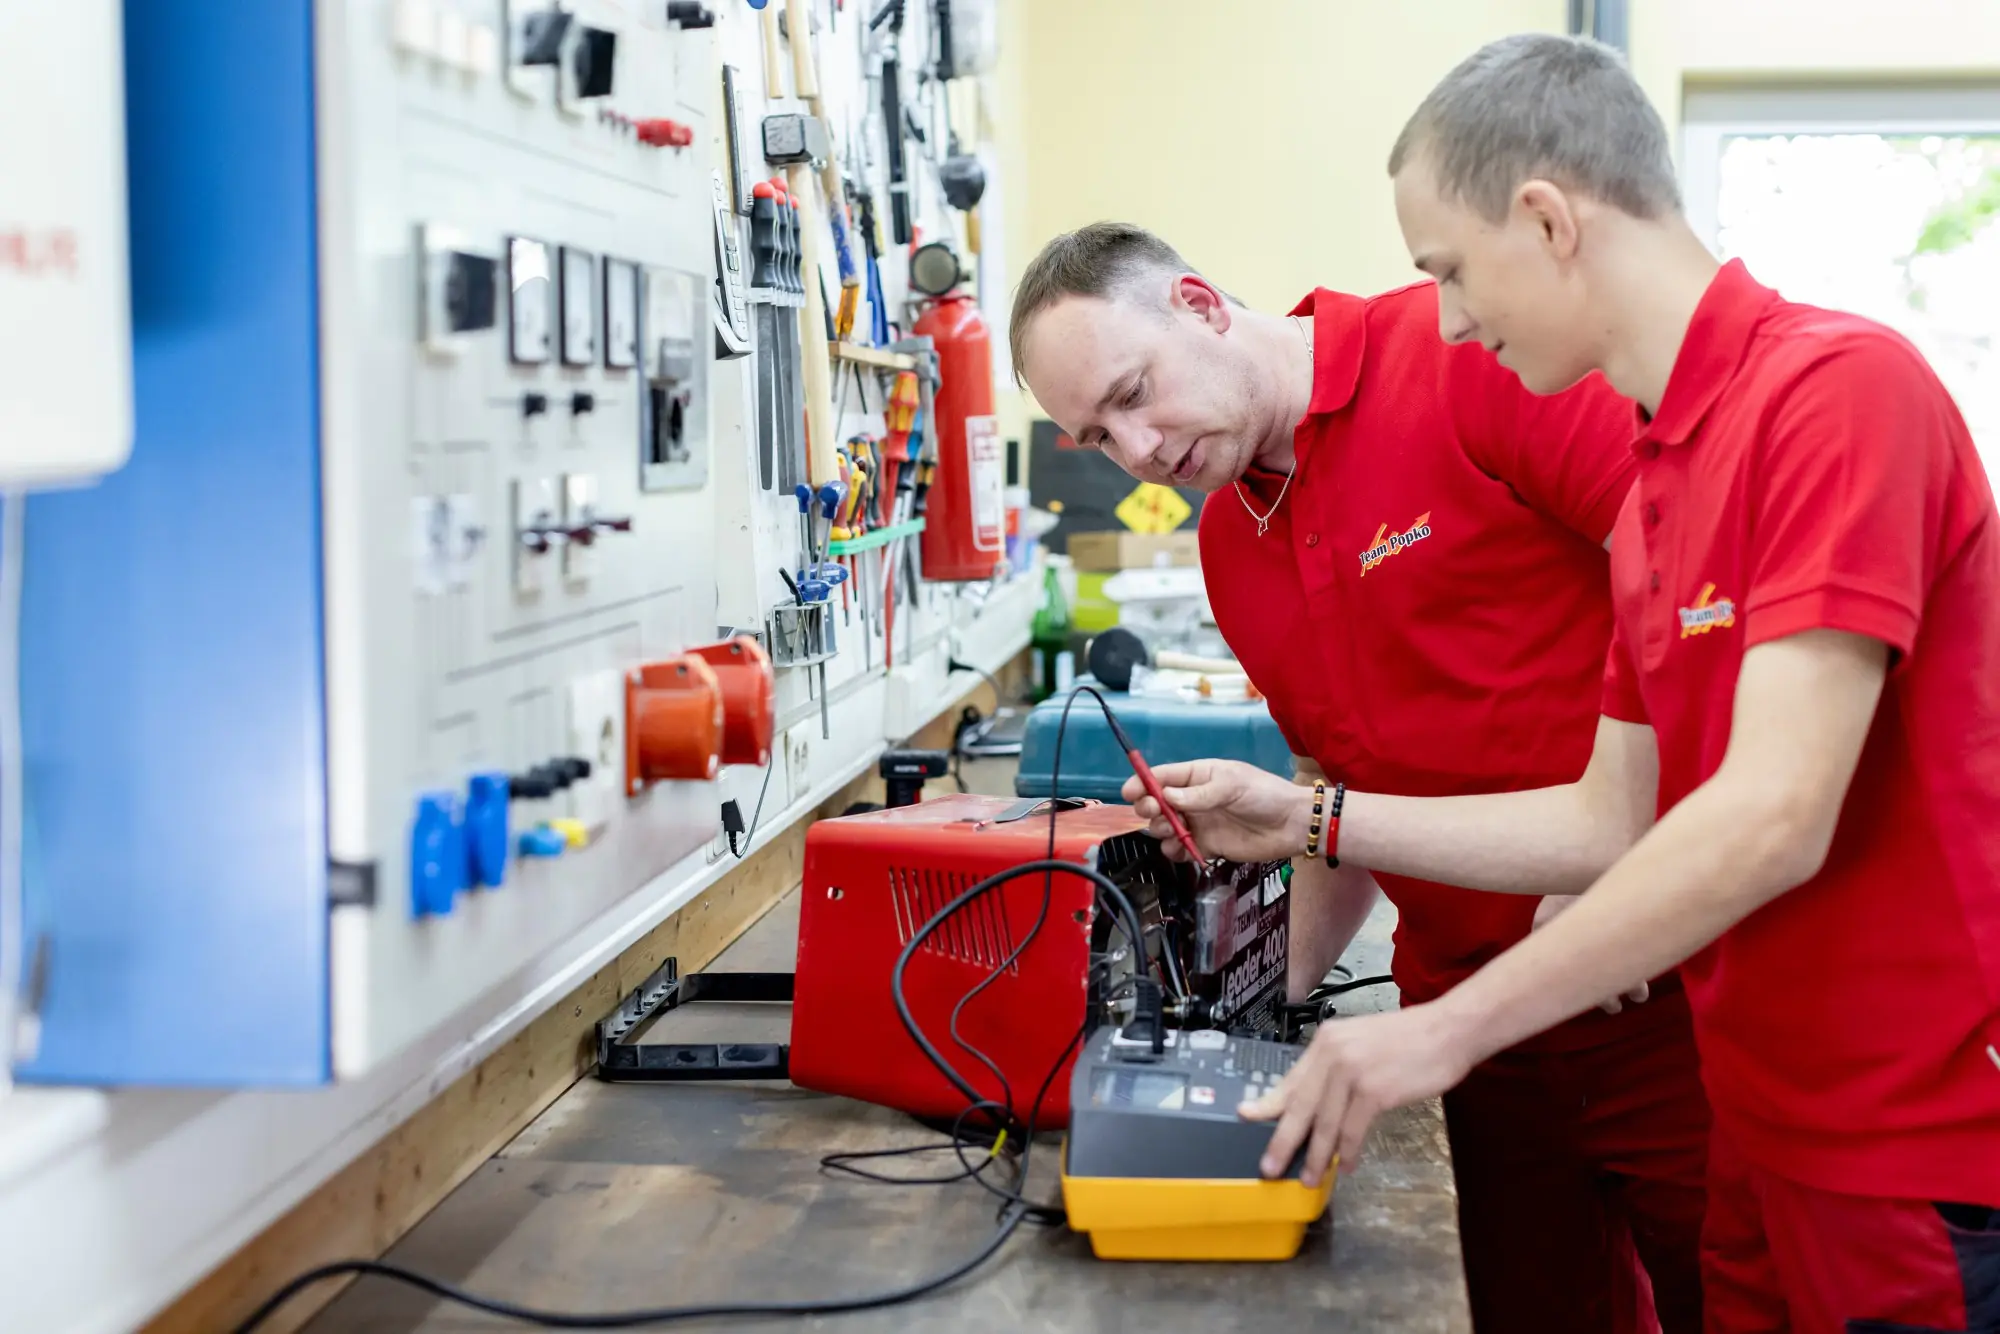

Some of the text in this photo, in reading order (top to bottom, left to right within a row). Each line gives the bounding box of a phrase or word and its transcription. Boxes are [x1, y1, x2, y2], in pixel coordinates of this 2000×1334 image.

[1359, 526, 1431, 565] Team Popko
[1263, 923, 1286, 969] 400
[1257, 960, 1285, 989] START
